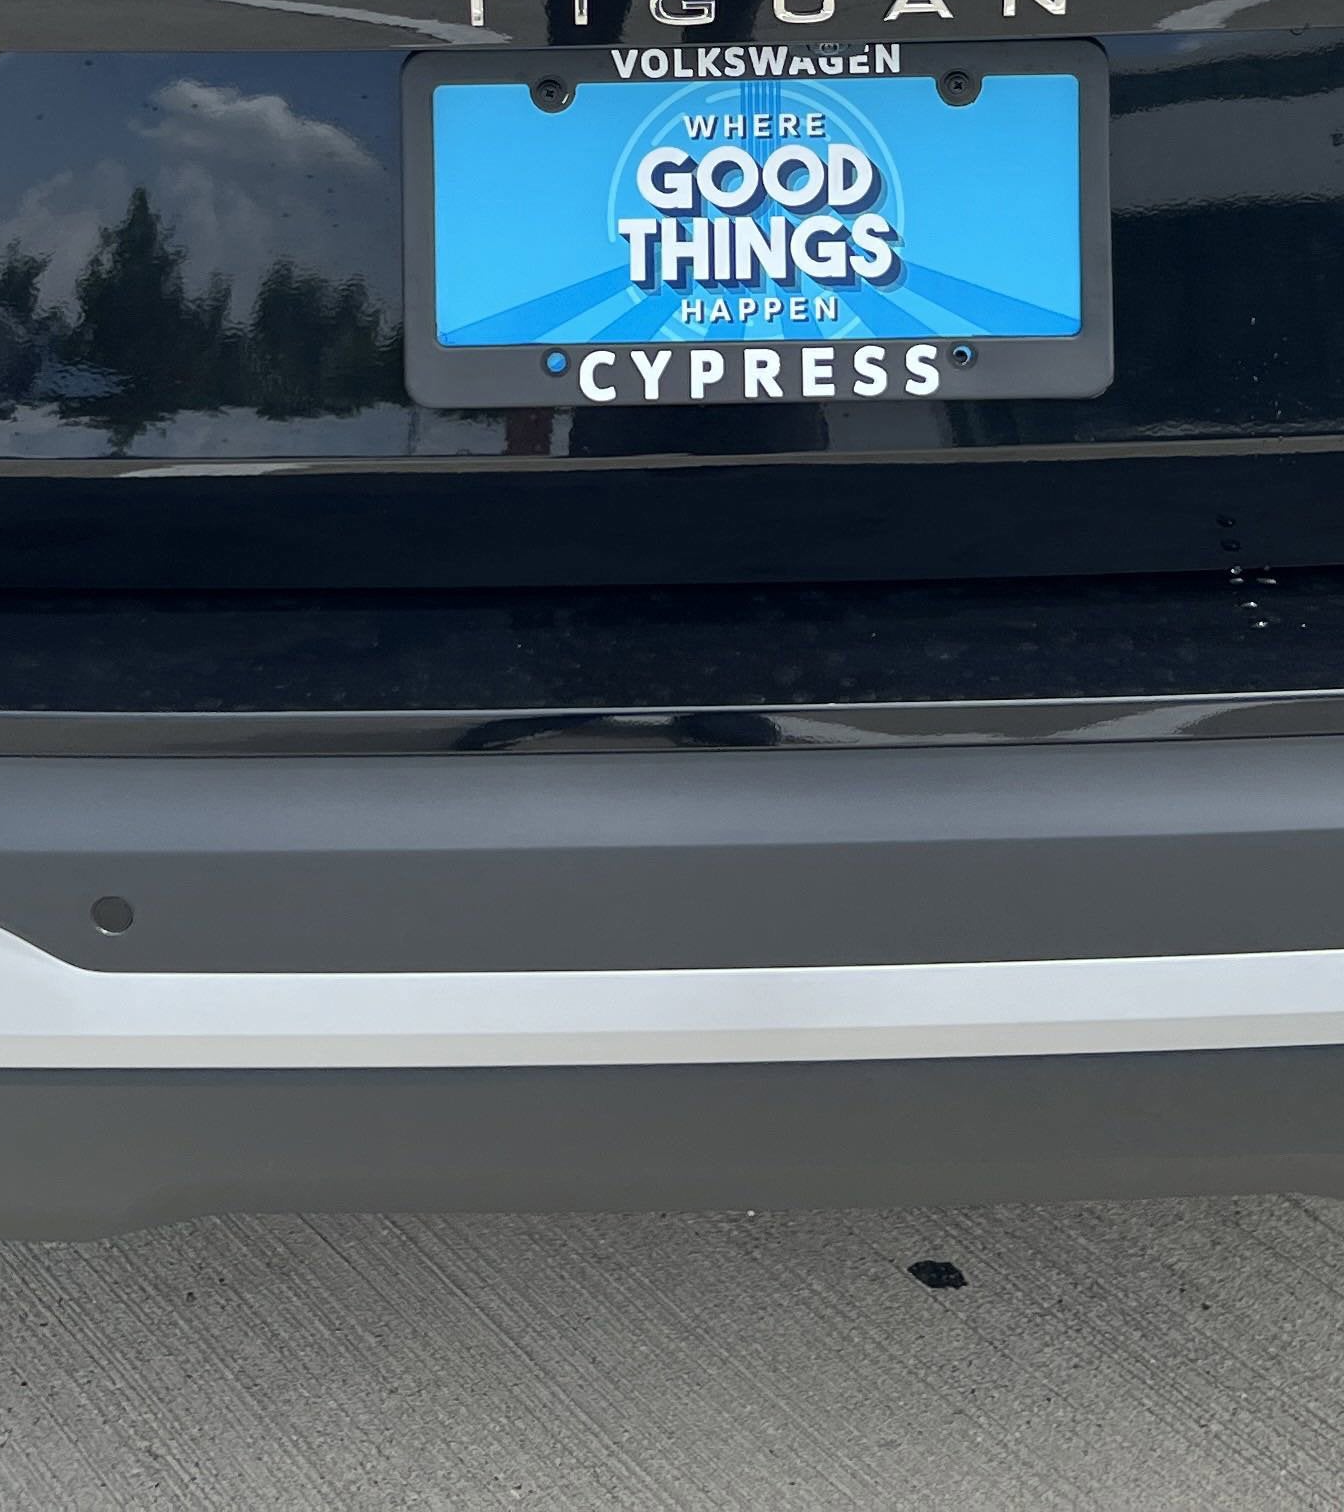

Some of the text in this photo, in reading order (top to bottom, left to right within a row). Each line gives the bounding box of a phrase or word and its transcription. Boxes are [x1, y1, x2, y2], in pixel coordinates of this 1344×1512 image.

[610, 43, 902, 80] VOLKSWAGEN
[683, 112, 827, 140] WHERE
[635, 143, 878, 212] GOOD
[618, 212, 897, 284] THINGS
[681, 296, 840, 324] HAPPEN
[578, 343, 940, 402] CYPRESS
